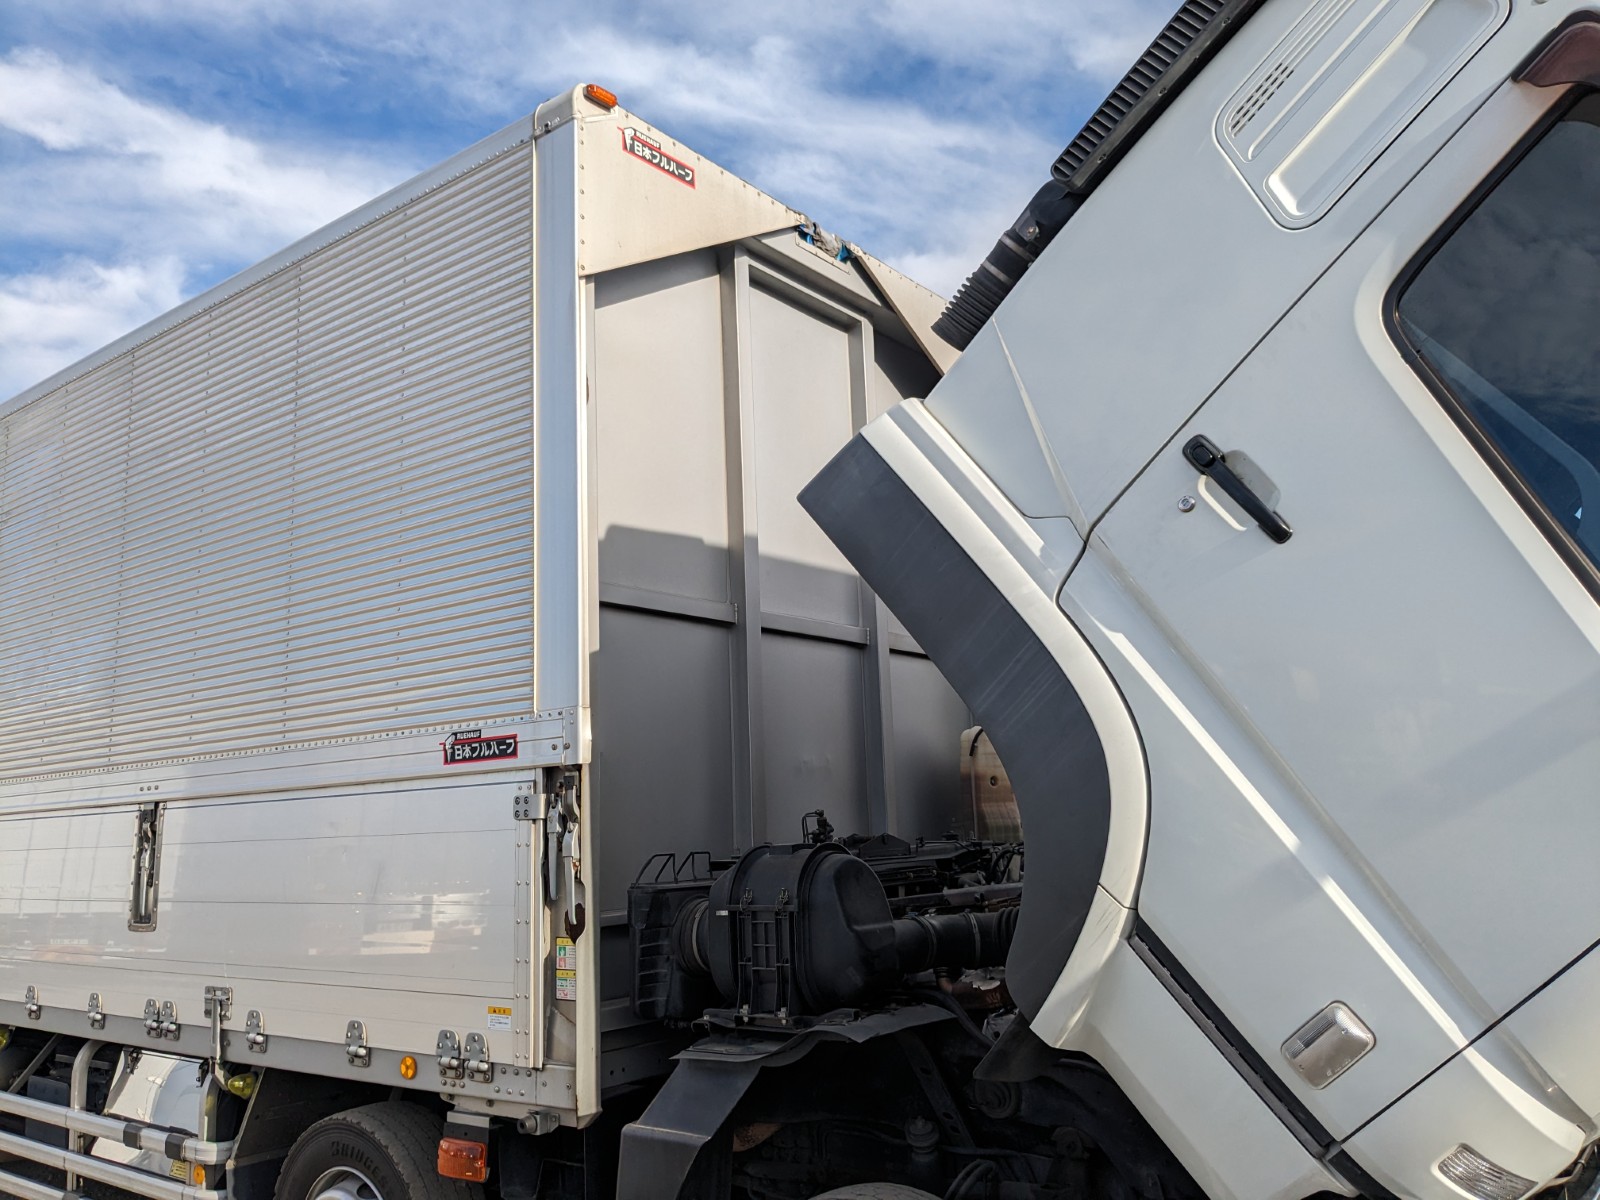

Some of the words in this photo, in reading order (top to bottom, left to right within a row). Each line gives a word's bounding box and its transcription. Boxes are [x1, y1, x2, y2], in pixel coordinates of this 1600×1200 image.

[635, 141, 692, 181] 日本フルハーフ
[454, 740, 515, 760] 日本フルハーフ
